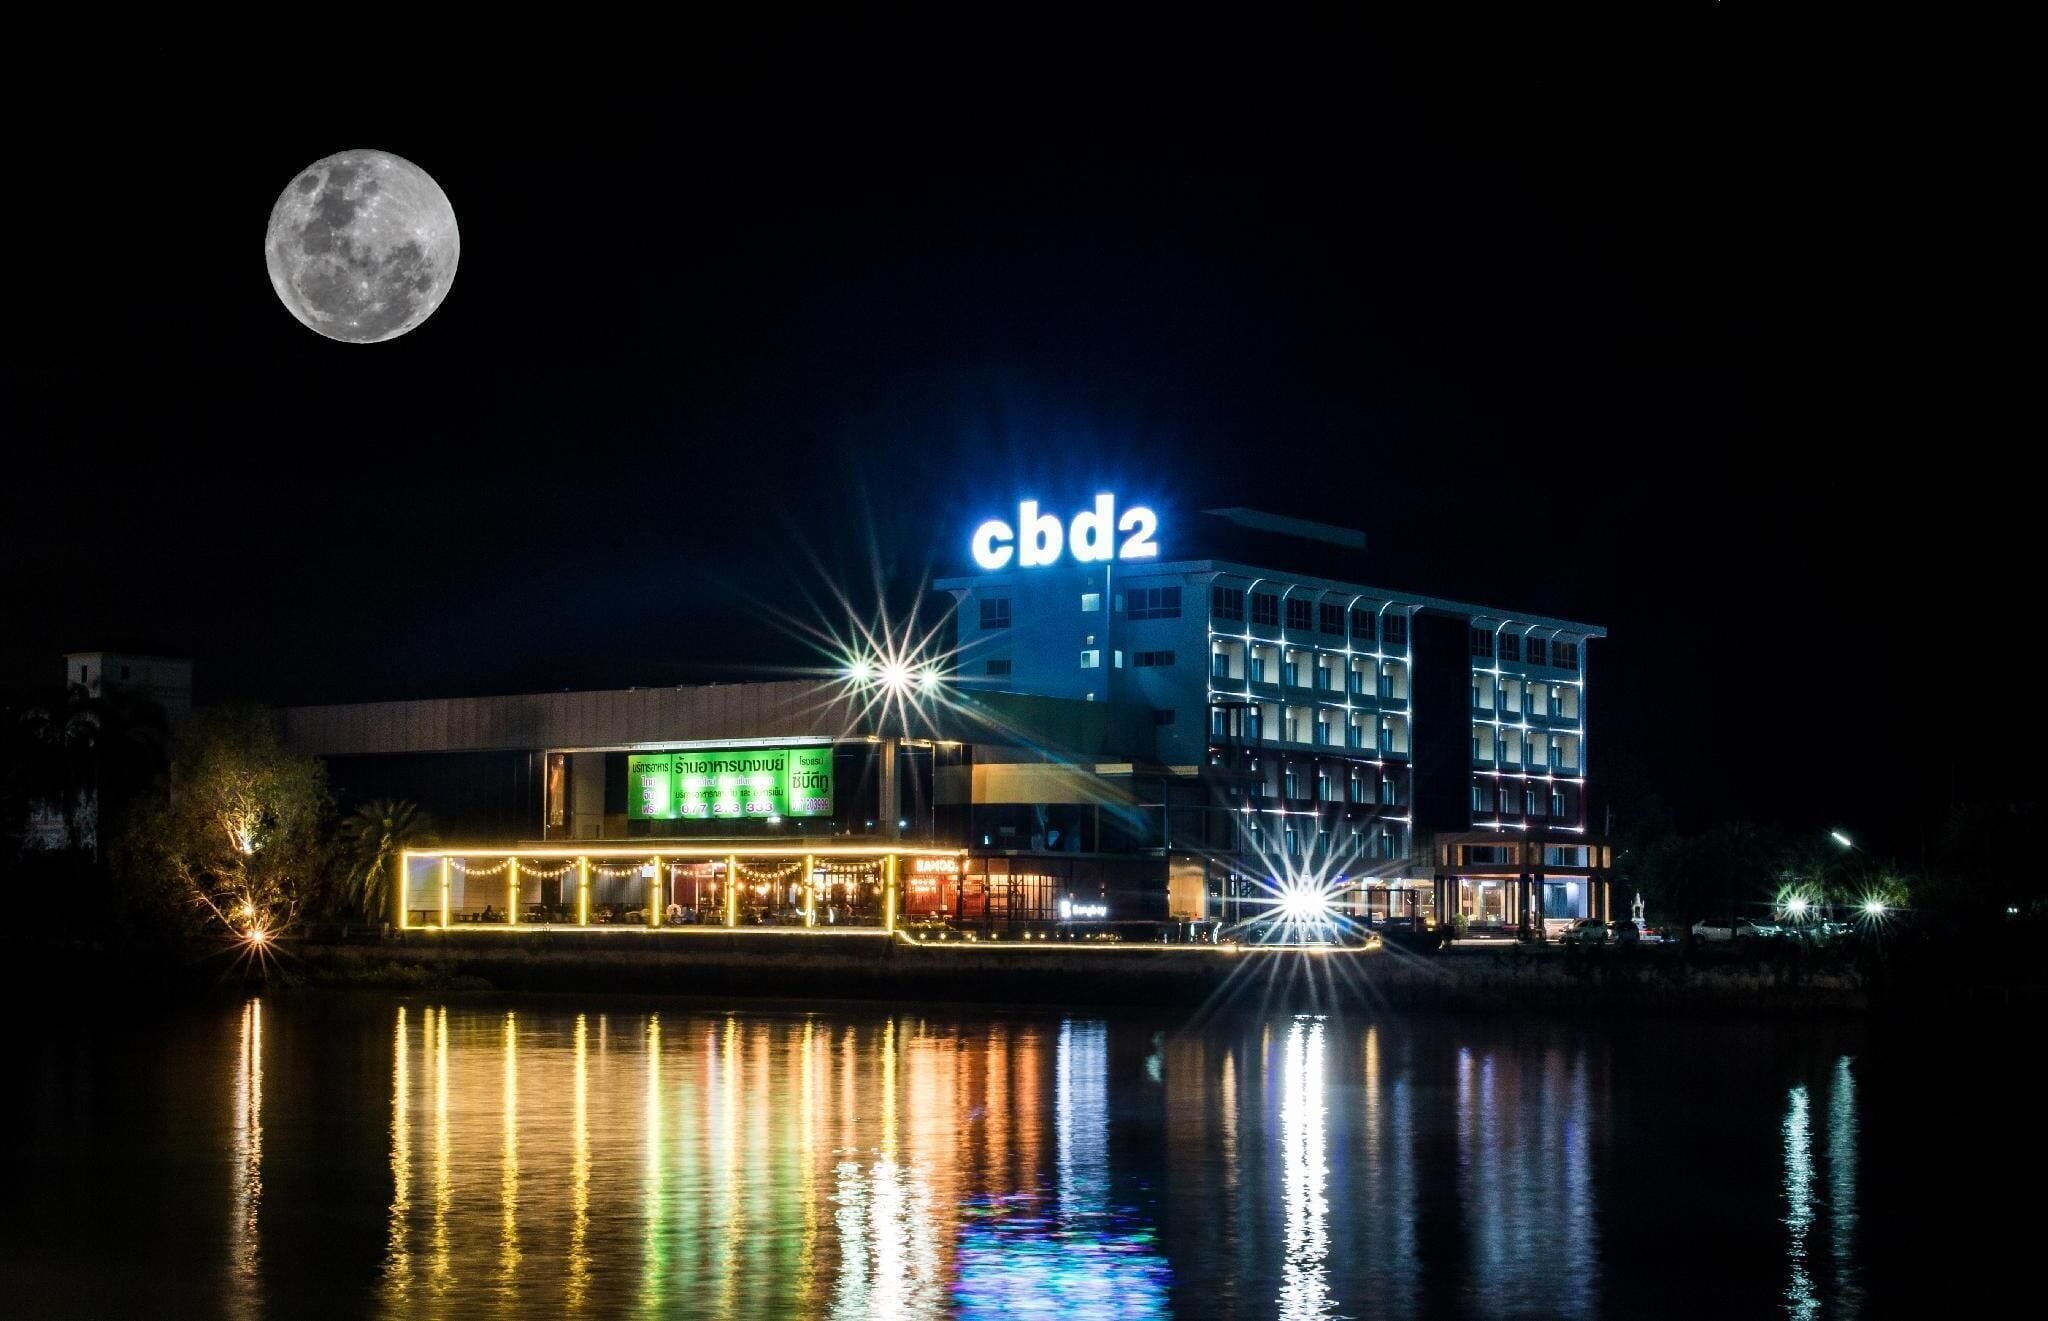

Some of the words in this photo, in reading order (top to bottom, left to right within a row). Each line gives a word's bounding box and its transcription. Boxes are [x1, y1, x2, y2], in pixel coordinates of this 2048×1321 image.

[972, 493, 1158, 570] cbd2
[632, 761, 669, 774] บริการอาหาร
[675, 753, 785, 774] ร้านอาหารบางเบย์
[799, 755, 824, 766] โรงแรม
[792, 771, 829, 794] ซีบีดีทู
